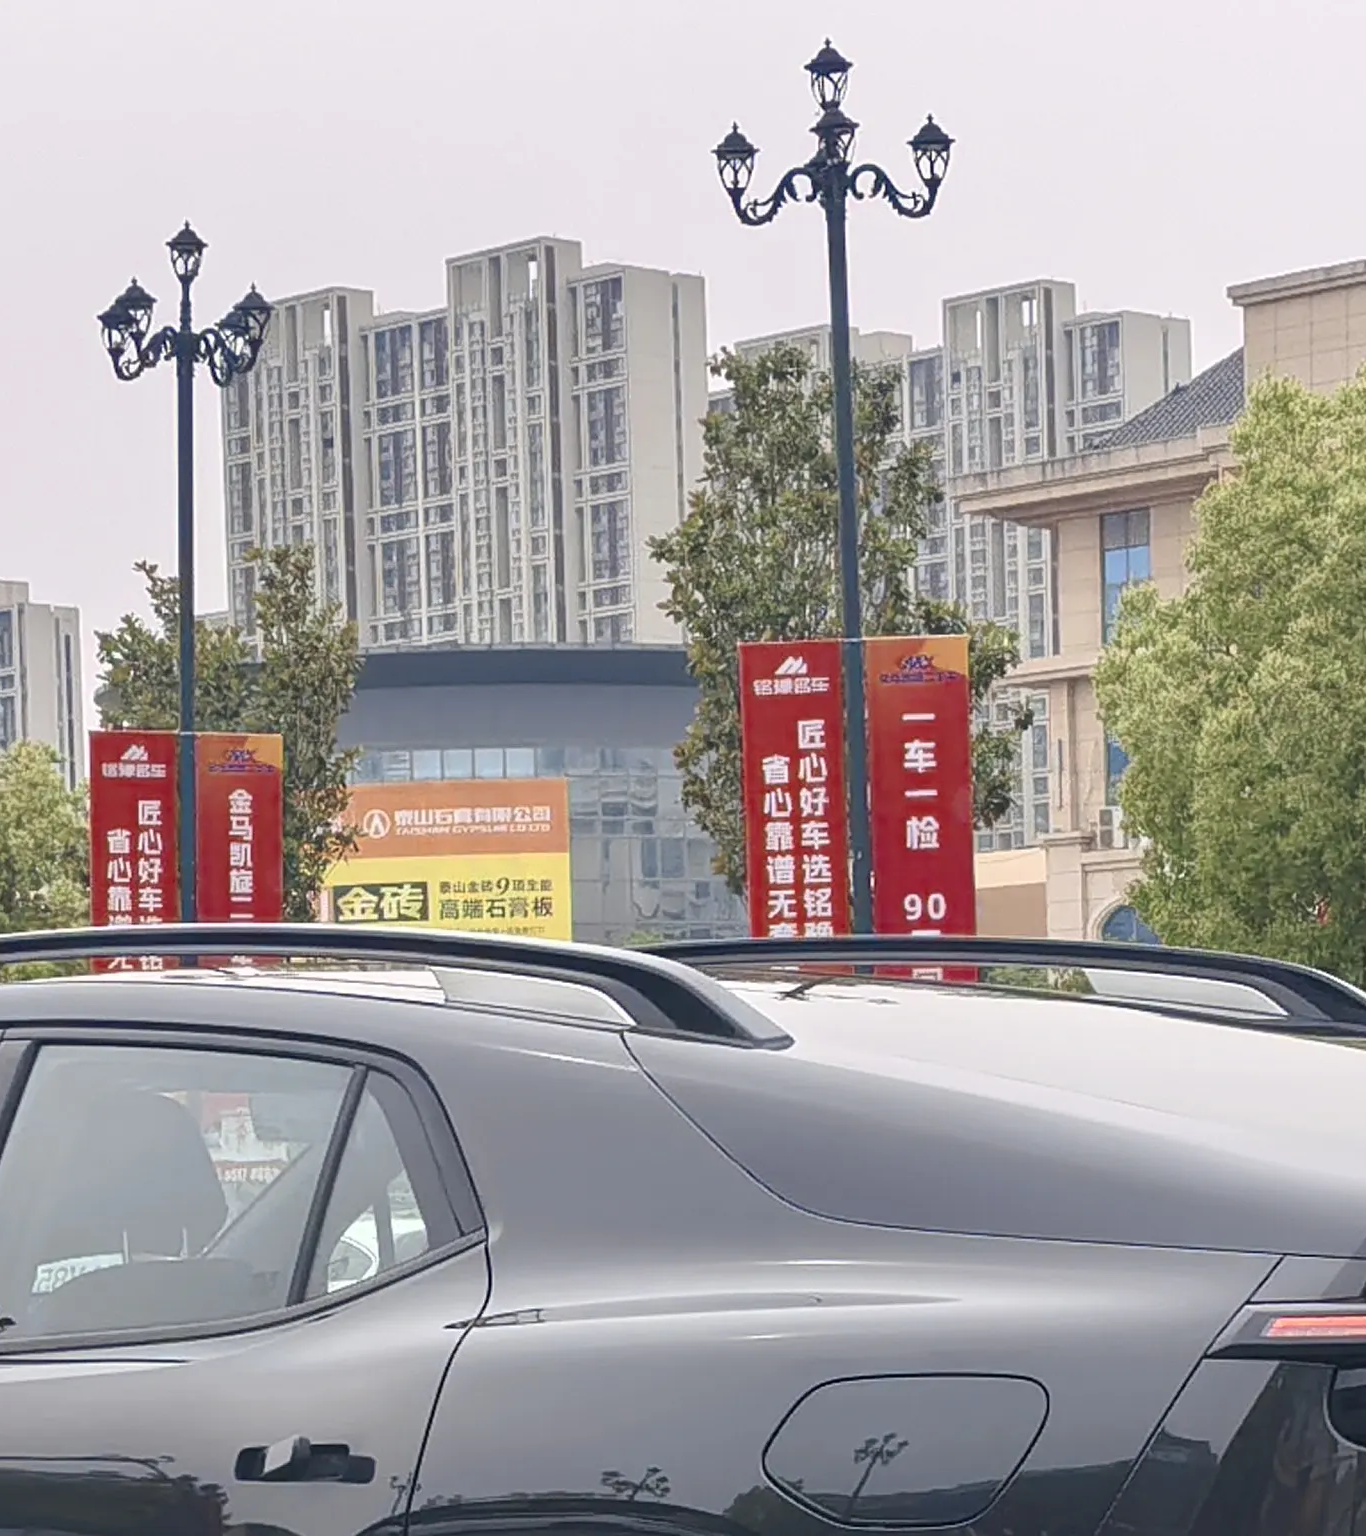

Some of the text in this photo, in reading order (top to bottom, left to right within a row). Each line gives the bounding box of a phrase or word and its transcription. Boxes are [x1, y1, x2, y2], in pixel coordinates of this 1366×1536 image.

[901, 712, 941, 851] 一车一检
[394, 805, 551, 827] 泰山石膏有限公司
[137, 799, 164, 925] 匠心好车
[335, 884, 425, 921] 金砖
[438, 896, 554, 920] 高端石膏板
[903, 892, 948, 921] 90
